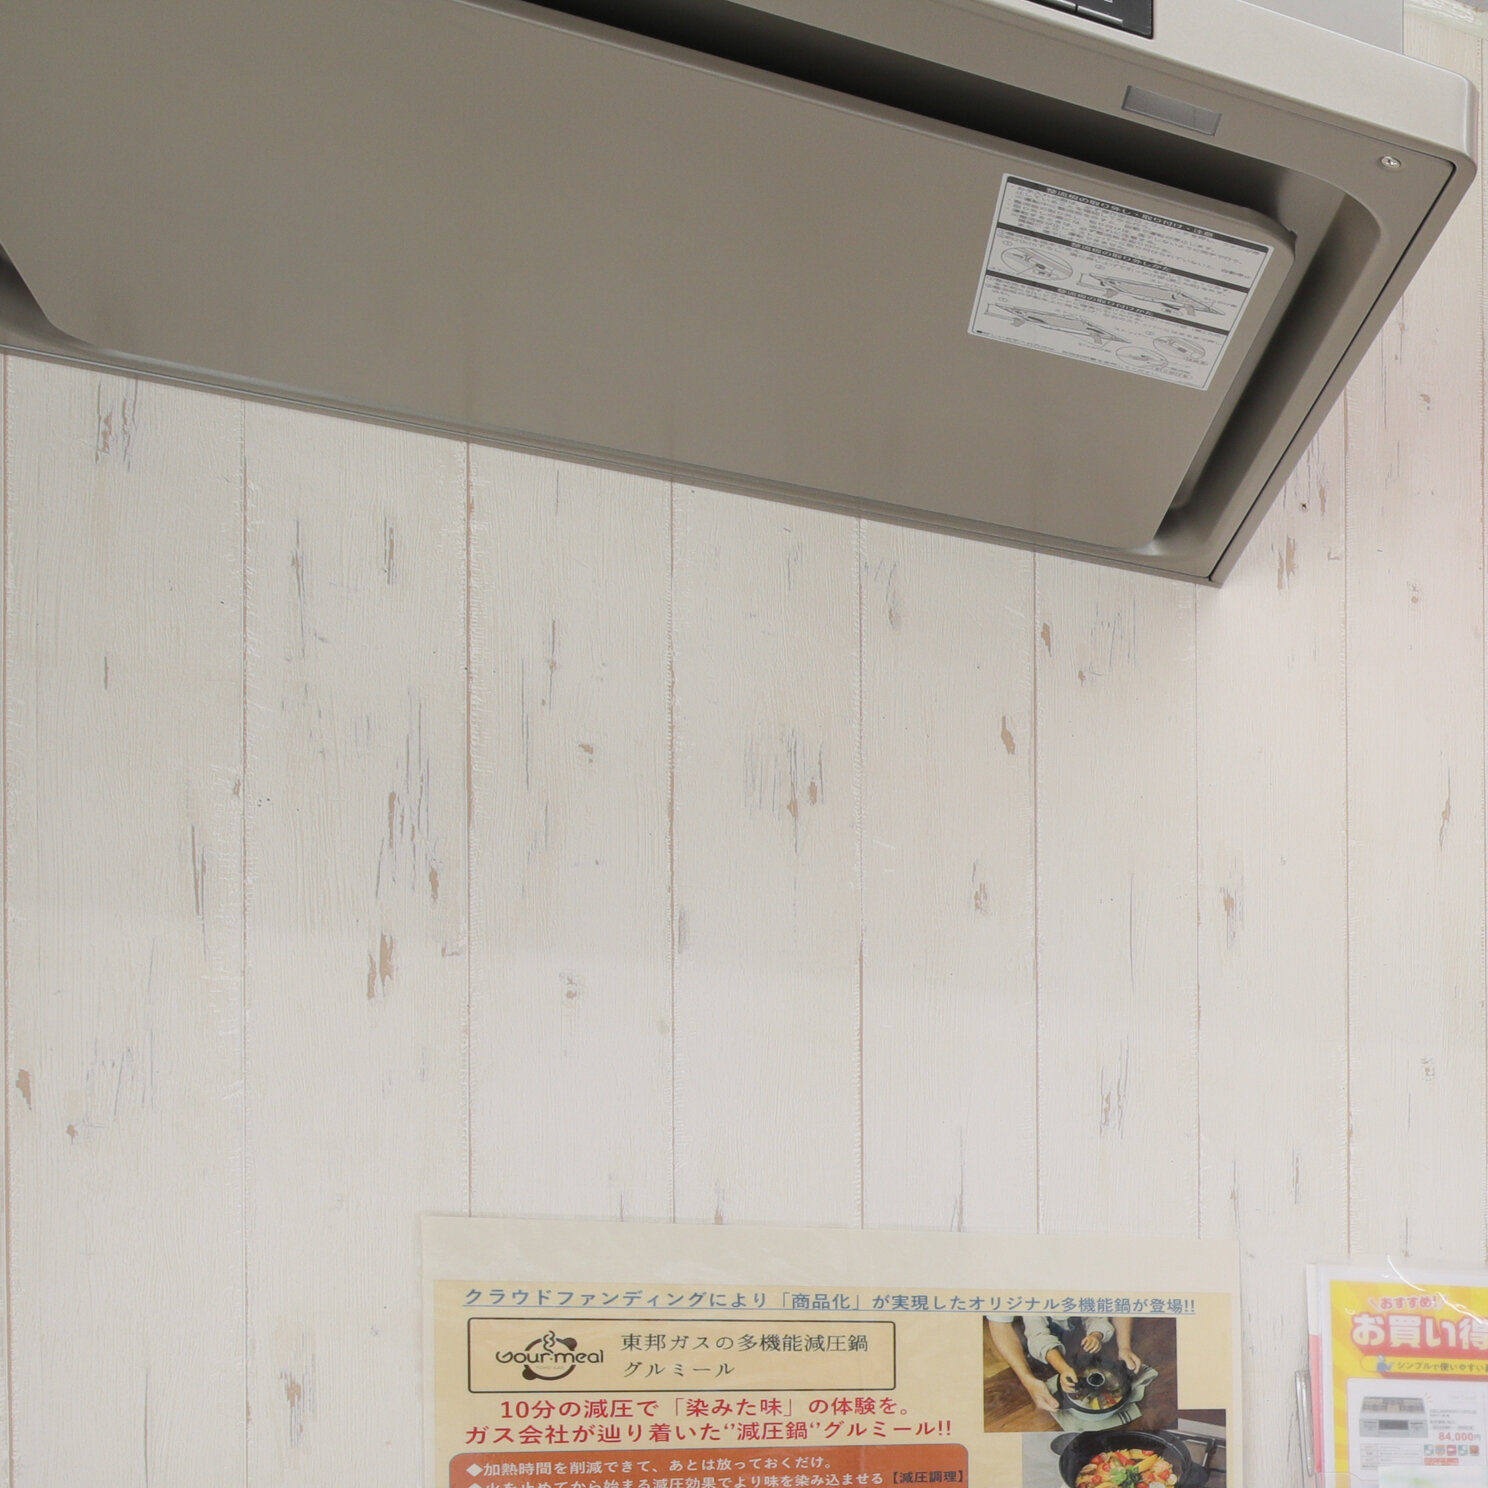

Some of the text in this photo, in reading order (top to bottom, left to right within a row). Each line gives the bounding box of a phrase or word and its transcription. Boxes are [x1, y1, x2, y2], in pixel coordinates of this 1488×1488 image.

[620, 1333, 868, 1352] 東邦ガスの多機能減圧鍋
[624, 1362, 735, 1378] グルミール
